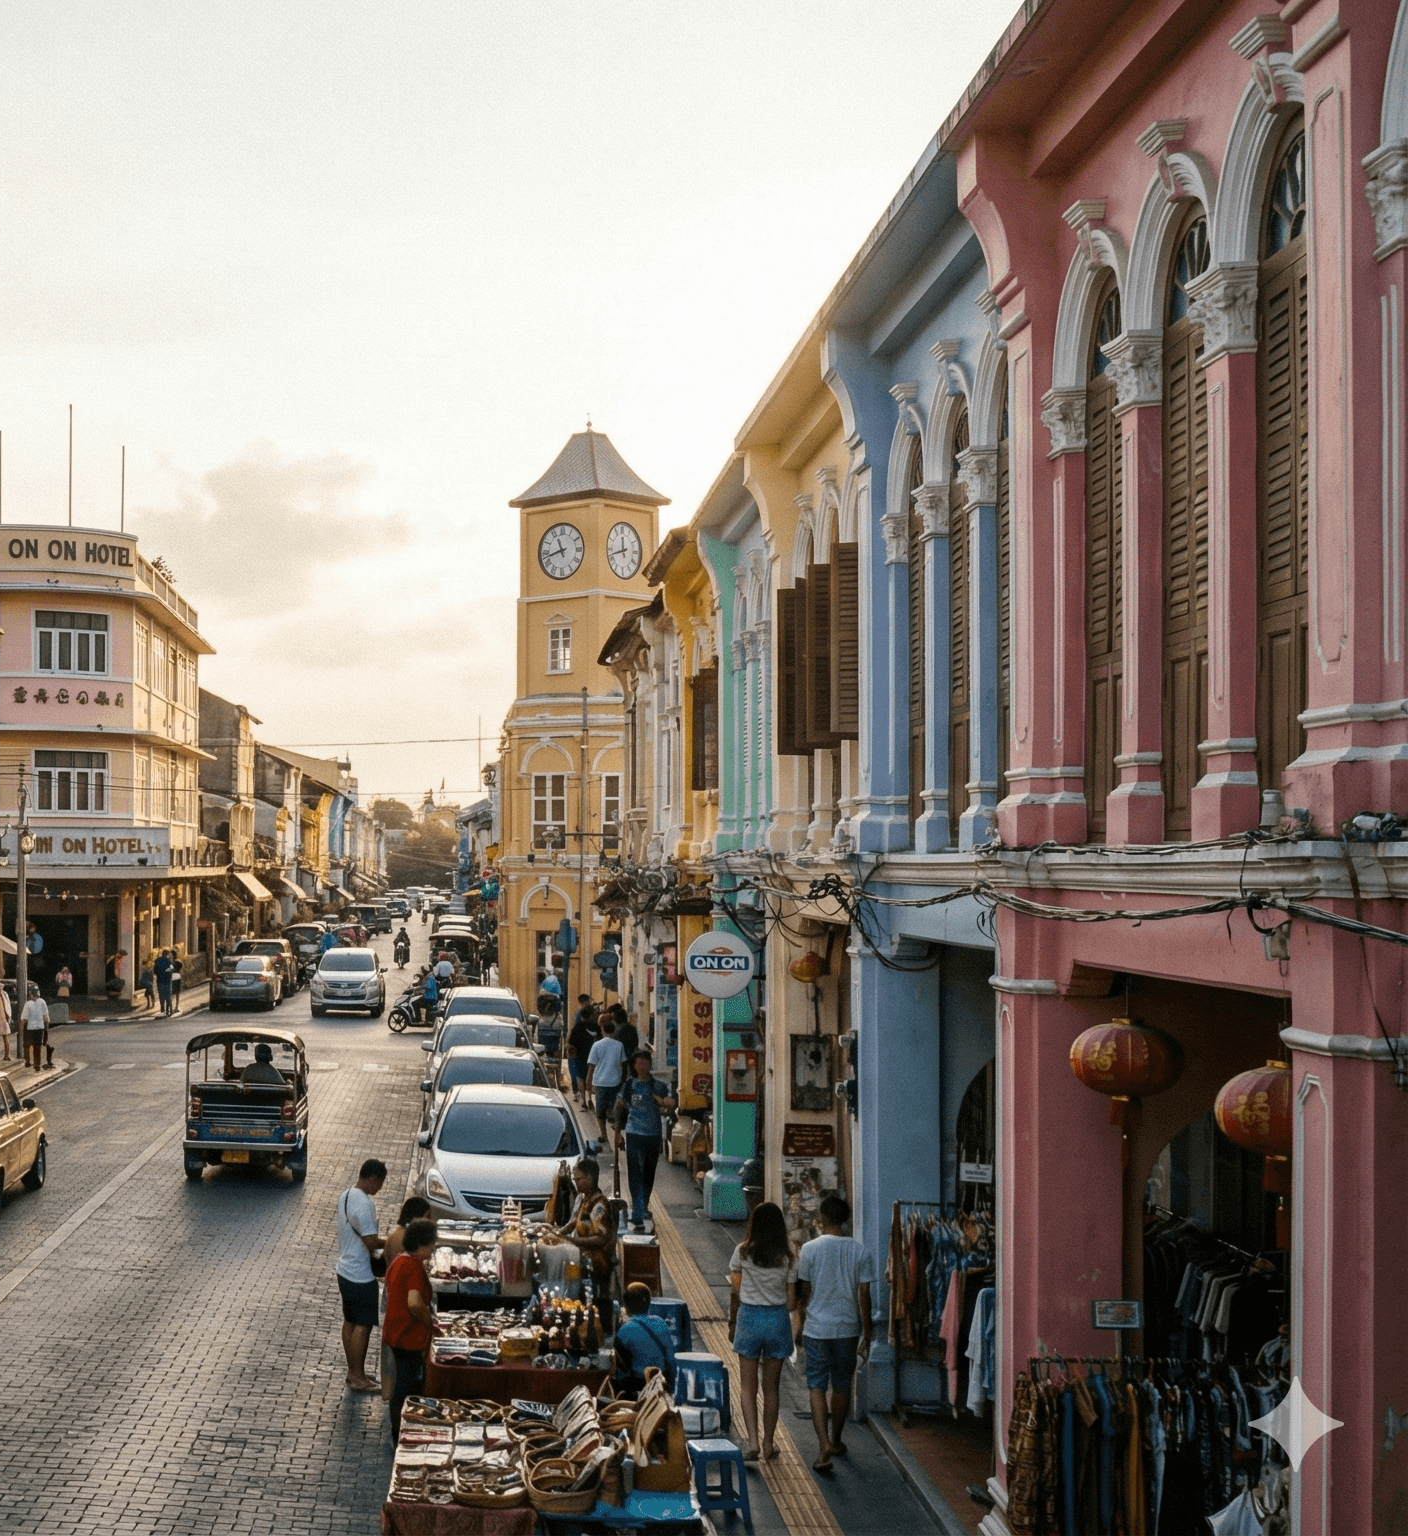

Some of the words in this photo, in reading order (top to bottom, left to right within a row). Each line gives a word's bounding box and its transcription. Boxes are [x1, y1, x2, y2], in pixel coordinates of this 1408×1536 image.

[8, 538, 38, 559] ON
[48, 540, 76, 561] ON
[85, 542, 133, 567] HOTEL
[62, 838, 86, 854] ON
[92, 837, 145, 854] HOTEL
[694, 957, 718, 969] ON
[721, 957, 745, 969] ON
